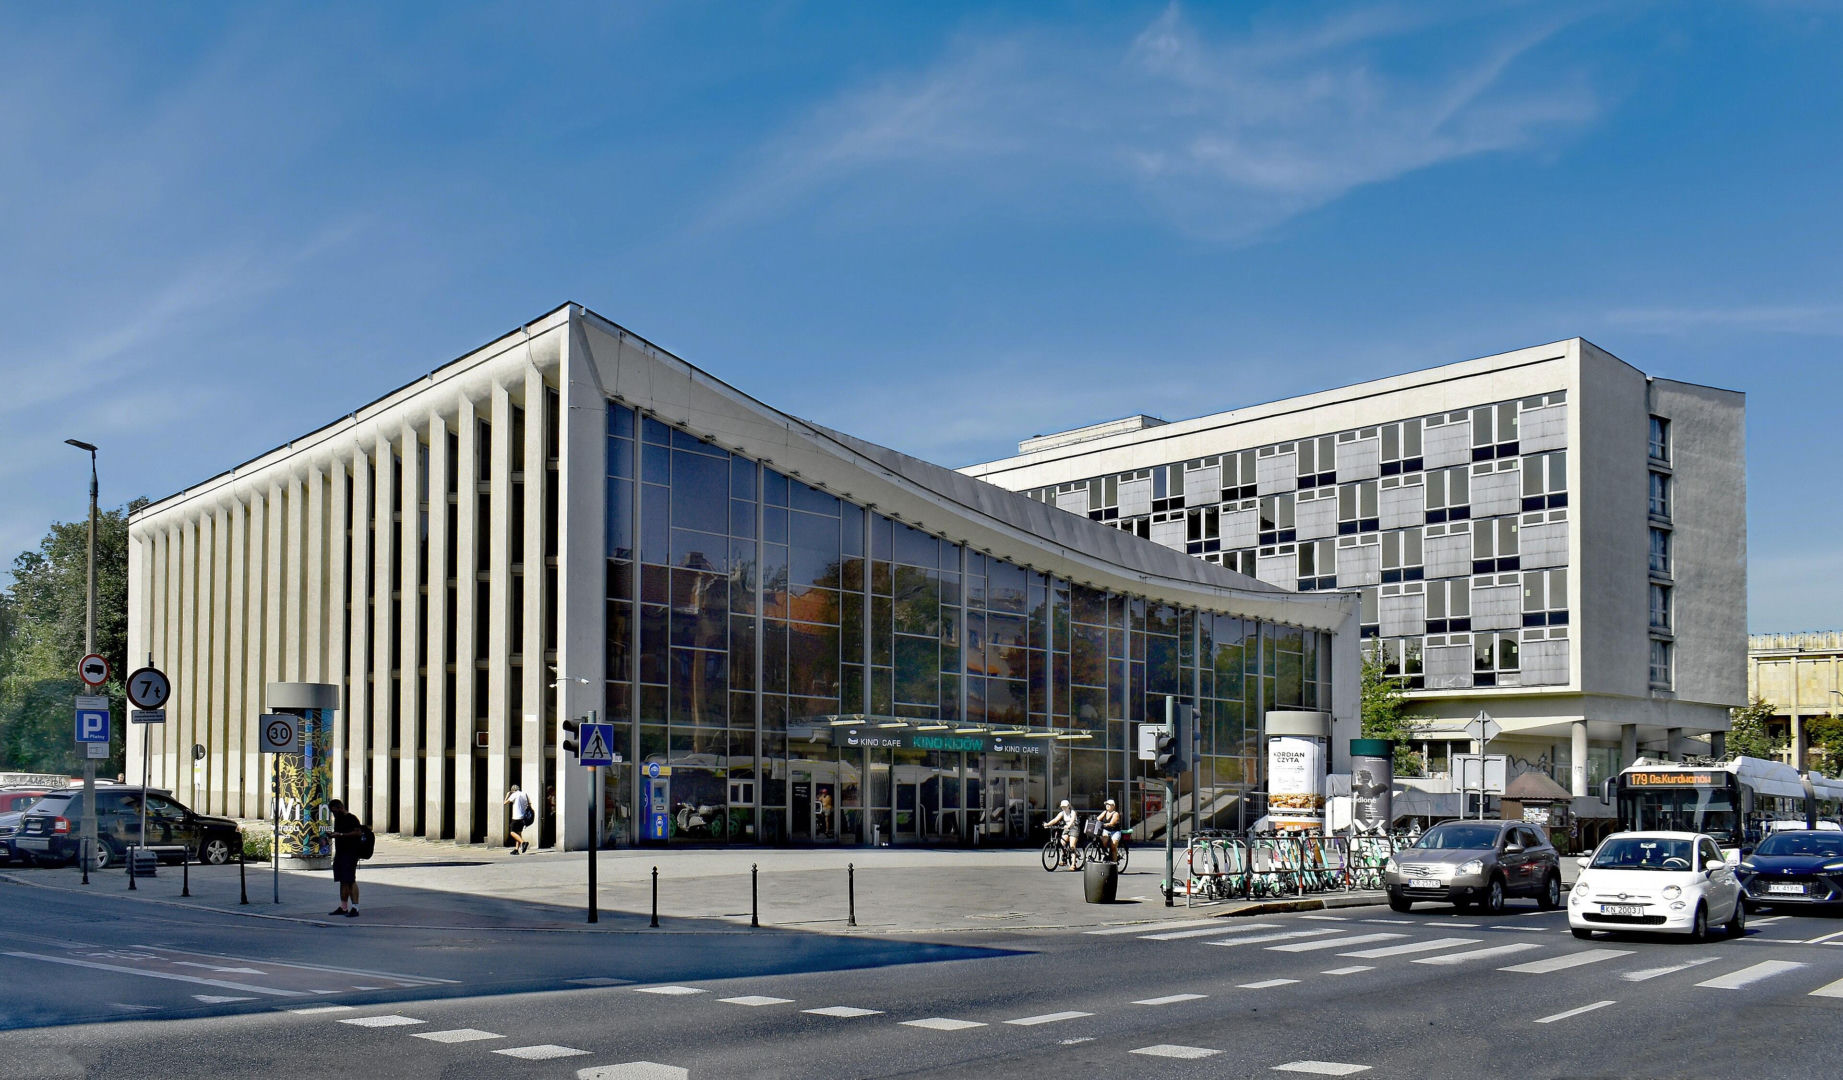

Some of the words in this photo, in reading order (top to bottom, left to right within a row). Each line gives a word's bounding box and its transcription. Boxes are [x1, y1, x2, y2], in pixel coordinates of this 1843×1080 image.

[270, 728, 288, 739] 30
[860, 738, 879, 747] KINO
[882, 739, 902, 748] CAFE
[913, 735, 942, 749] KINO
[1004, 745, 1020, 753] KINO
[1022, 746, 1039, 754] CAFE
[1631, 773, 1648, 786] 179
[1605, 905, 1616, 913] KN
[1617, 906, 1642, 914] 2003J
